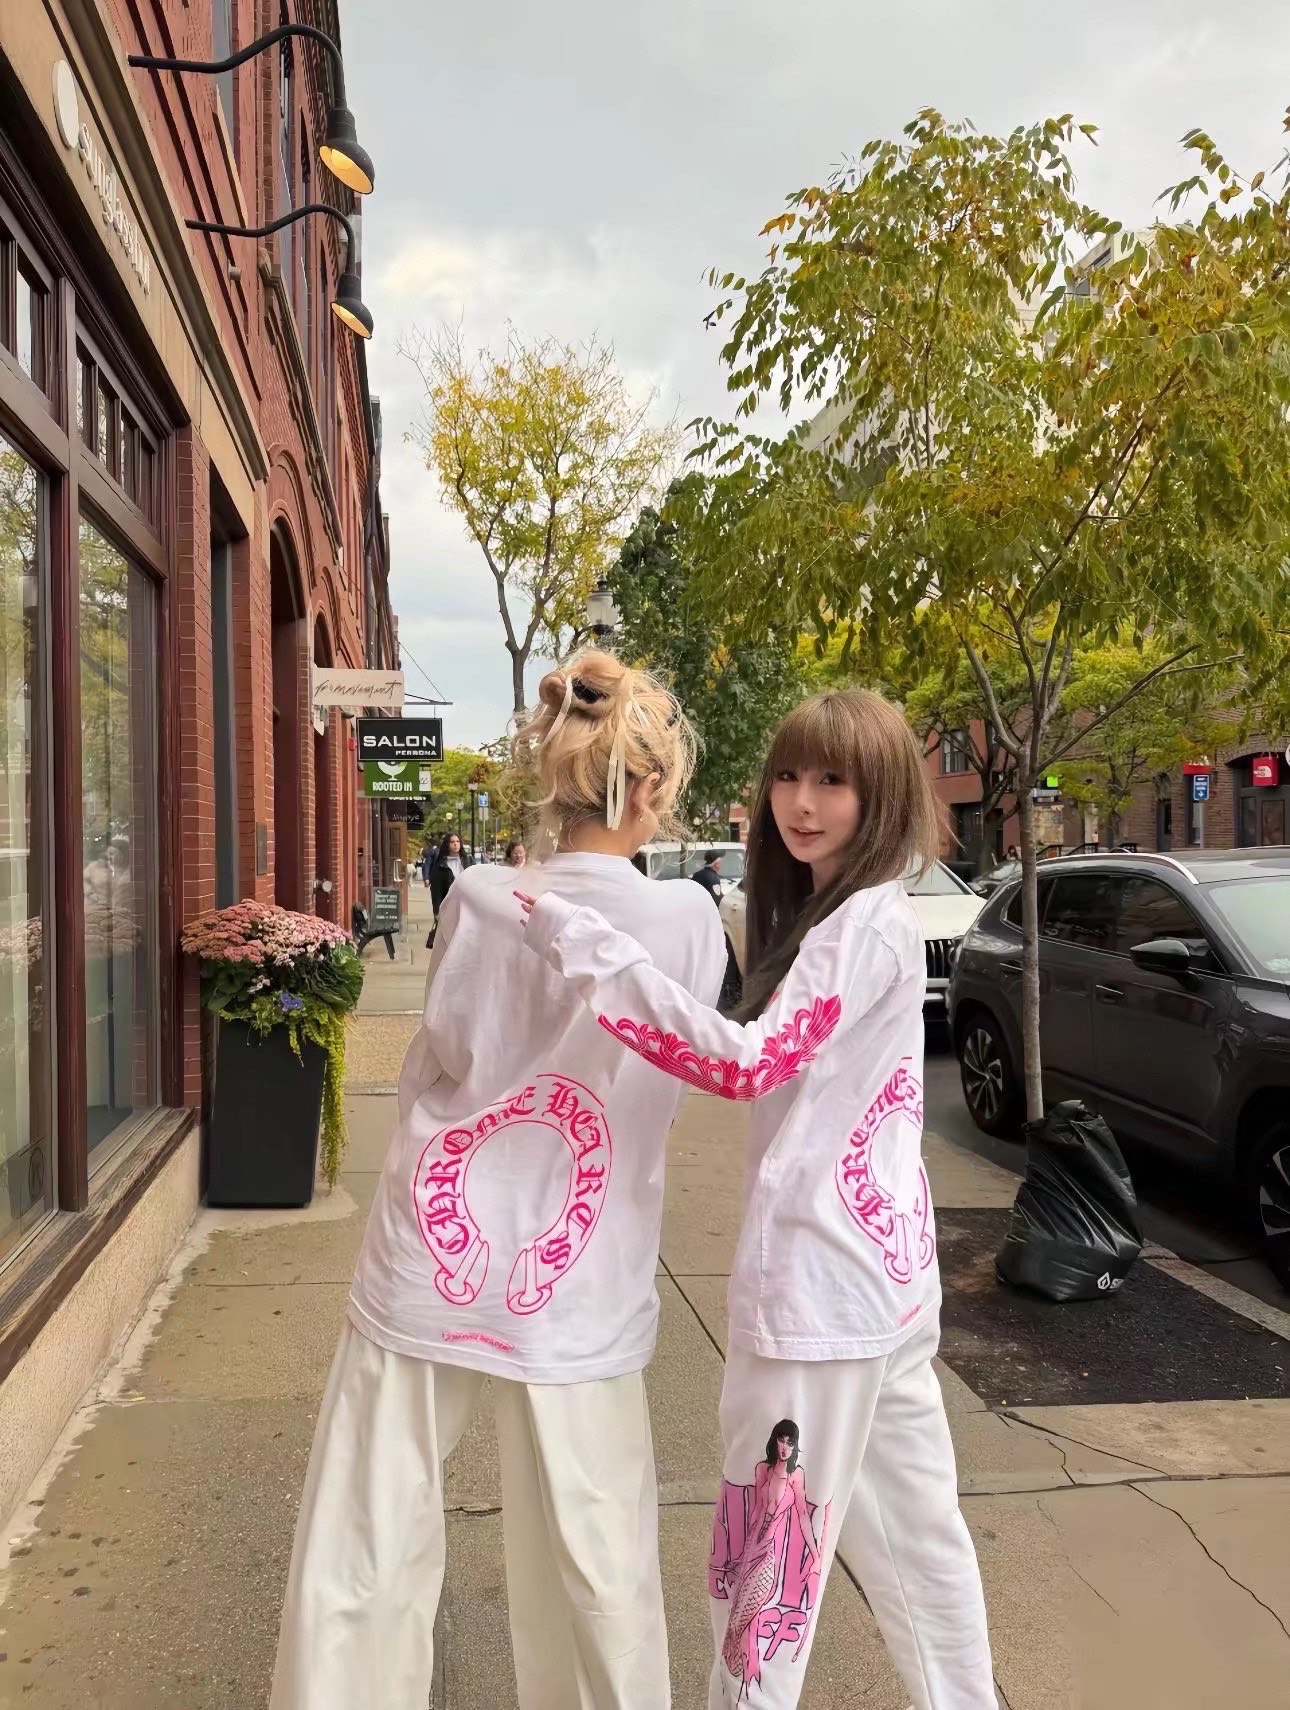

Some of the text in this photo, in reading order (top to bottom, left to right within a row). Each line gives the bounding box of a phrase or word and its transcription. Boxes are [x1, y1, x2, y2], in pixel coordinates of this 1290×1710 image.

[363, 735, 437, 747] SALON
[372, 781, 403, 791] ROOTED
[403, 781, 413, 792] IN
